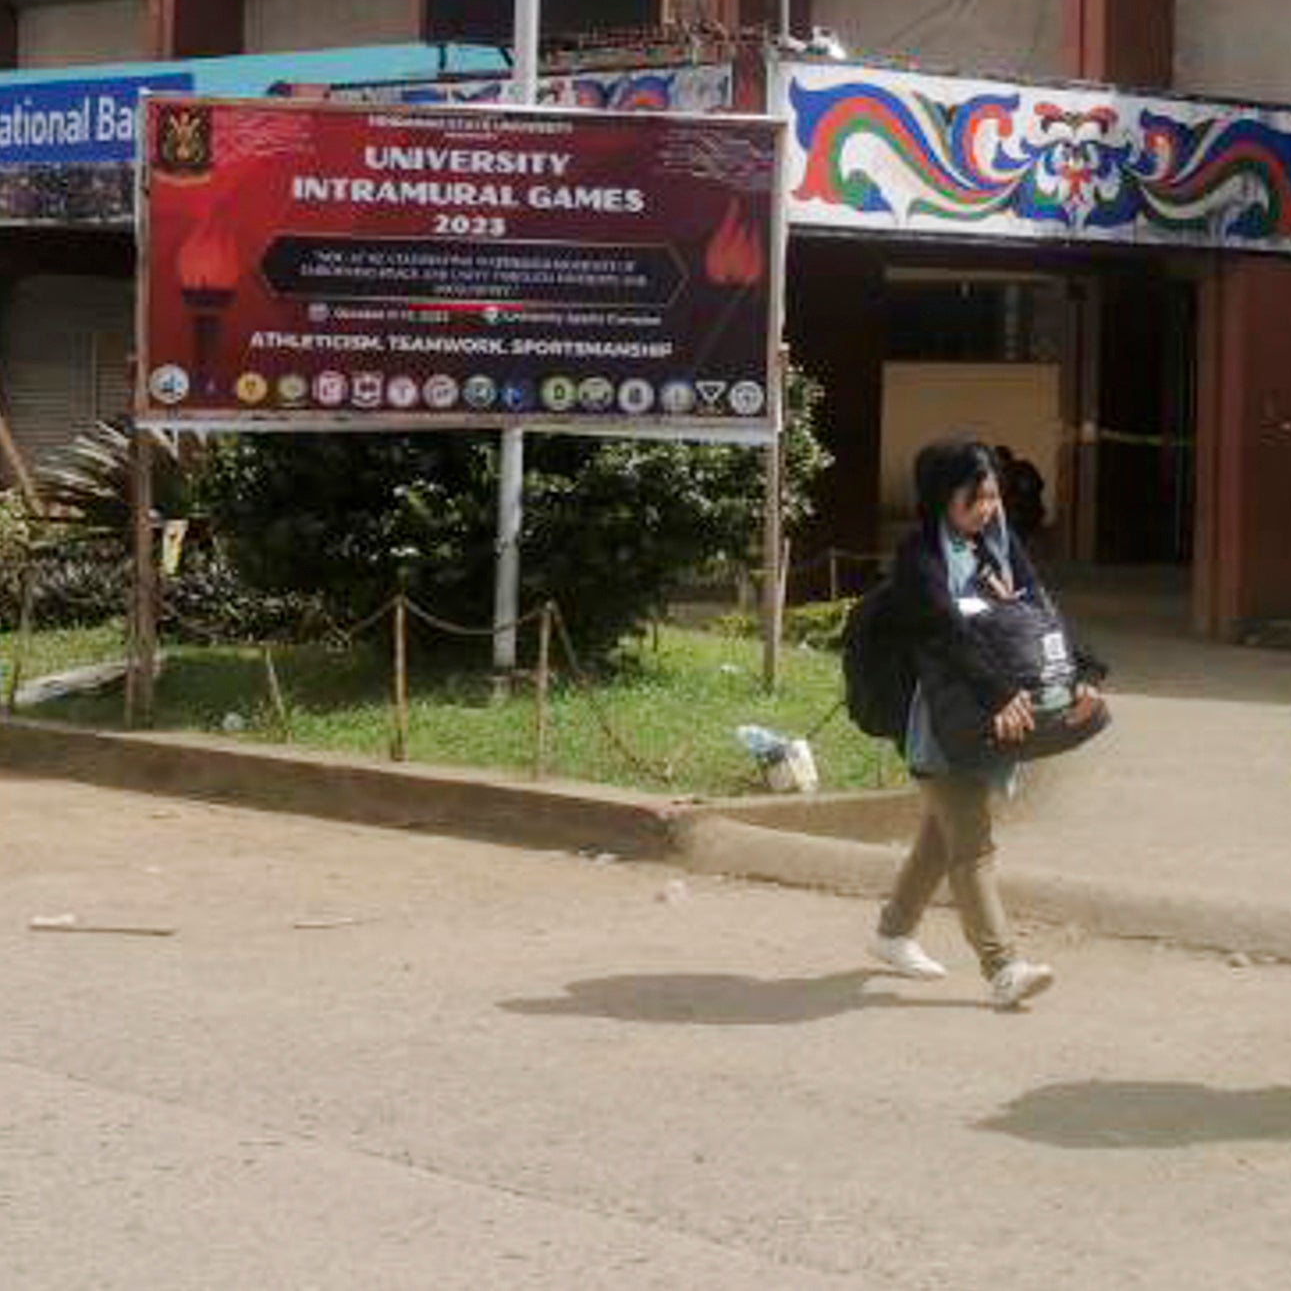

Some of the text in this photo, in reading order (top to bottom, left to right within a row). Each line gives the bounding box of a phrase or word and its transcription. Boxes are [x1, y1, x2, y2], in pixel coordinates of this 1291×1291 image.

[364, 146, 571, 176] UNIVERSITY
[293, 176, 645, 213] INTRAMURAL GAMES
